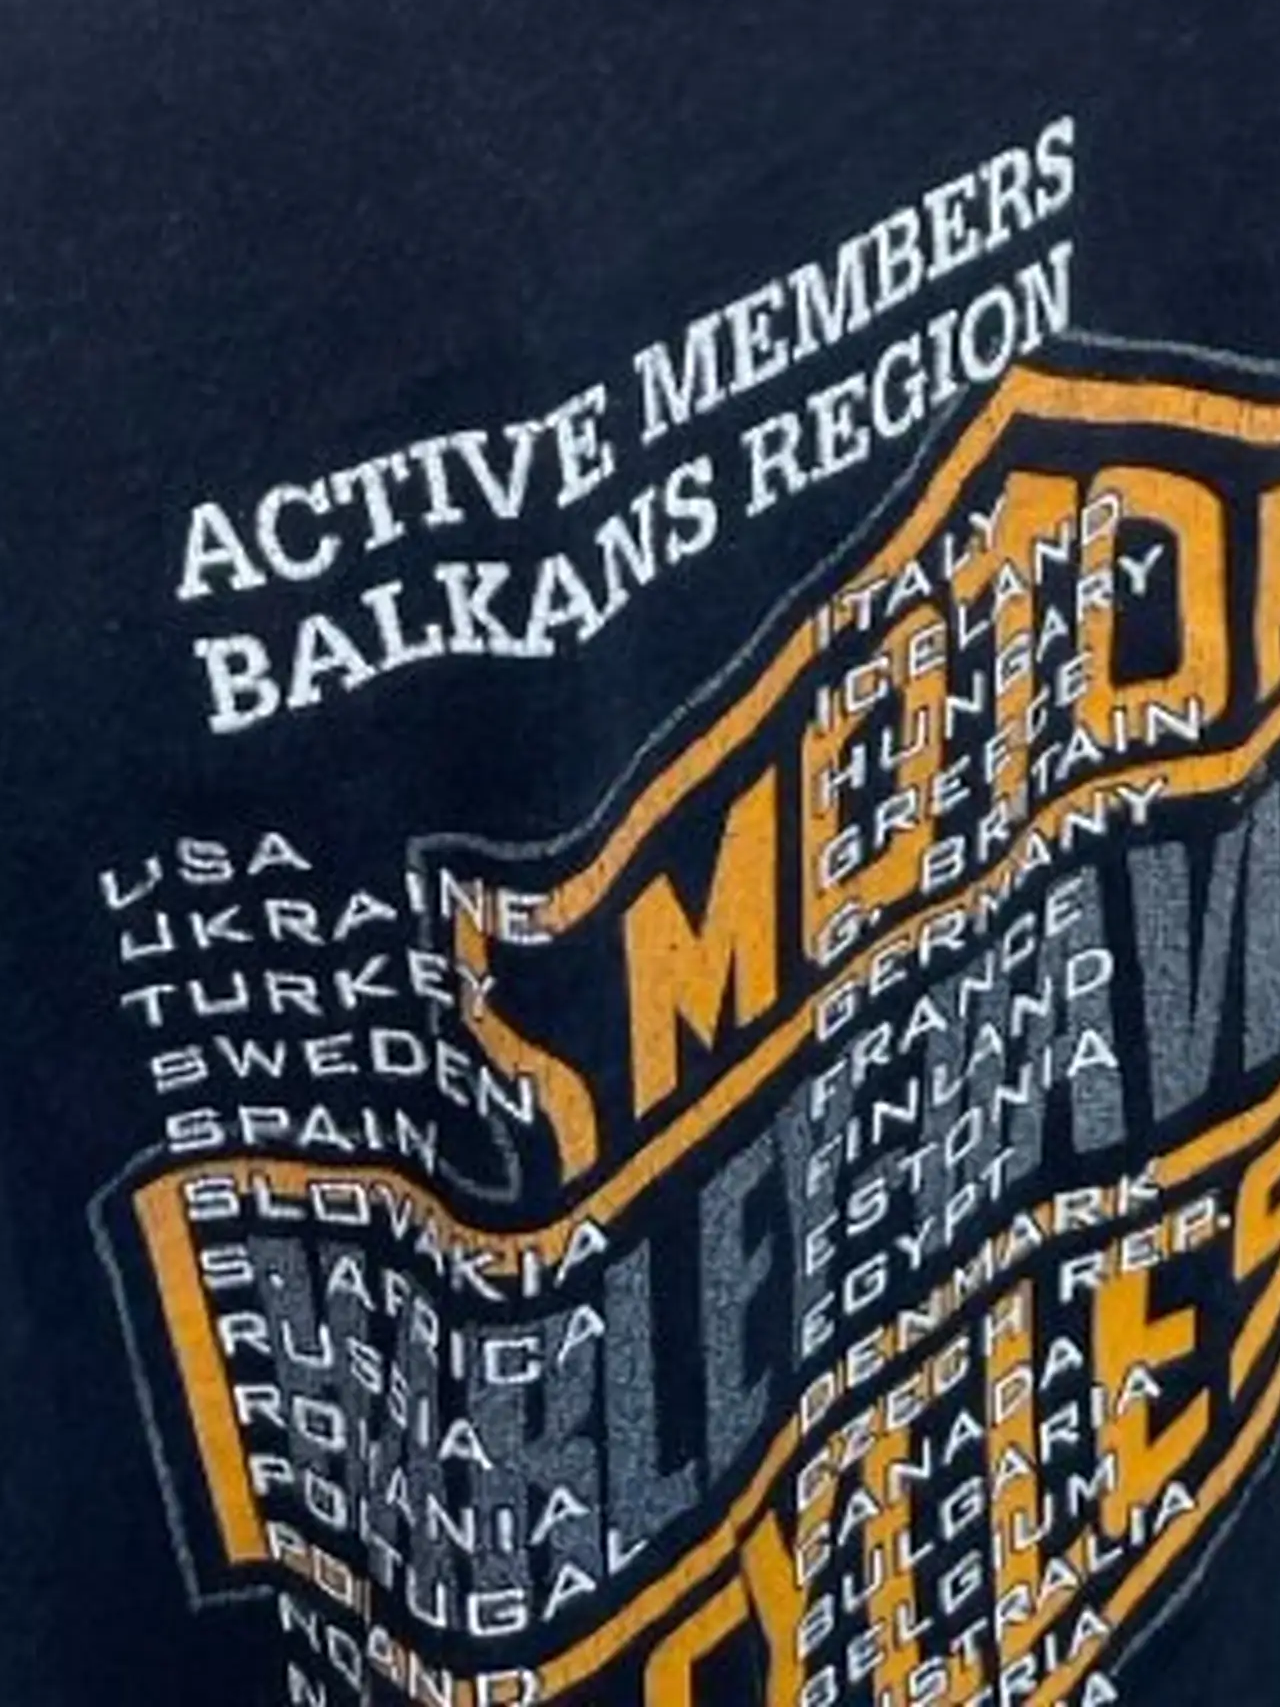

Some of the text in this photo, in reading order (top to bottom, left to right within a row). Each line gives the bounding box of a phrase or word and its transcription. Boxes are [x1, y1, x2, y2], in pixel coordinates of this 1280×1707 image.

[176, 114, 1076, 600] ACTIVE MEMBERS
[193, 241, 1075, 736] BALKANS REGION
[817, 498, 1006, 648] ITALY
[818, 494, 1118, 726] ICELAND
[821, 545, 1163, 804] HUNGARY
[100, 832, 312, 910] USA
[120, 867, 553, 961] UKRAINE
[120, 948, 496, 1026] TURKEY
[817, 779, 1165, 1042] GERMANY
[152, 1028, 534, 1125] SWEDEN
[807, 948, 1114, 1197] FINLAND
[811, 876, 1083, 1121] FRANCE
[166, 1104, 437, 1170] SPAIN
[184, 1175, 608, 1301] SLOVAKIA
[801, 1149, 1014, 1357] EGYPT
[806, 1029, 1118, 1274] ESTONIA
[200, 1246, 606, 1385] S. AFRICA
[218, 1314, 493, 1471] RUSSIA
[798, 1191, 1231, 1510] CZECH REP.
[801, 1158, 1159, 1432] DENMARK
[797, 1336, 1082, 1585] CANADA
[798, 1366, 1161, 1657] BULGARIA
[801, 1453, 1116, 1707] BELGIUM
